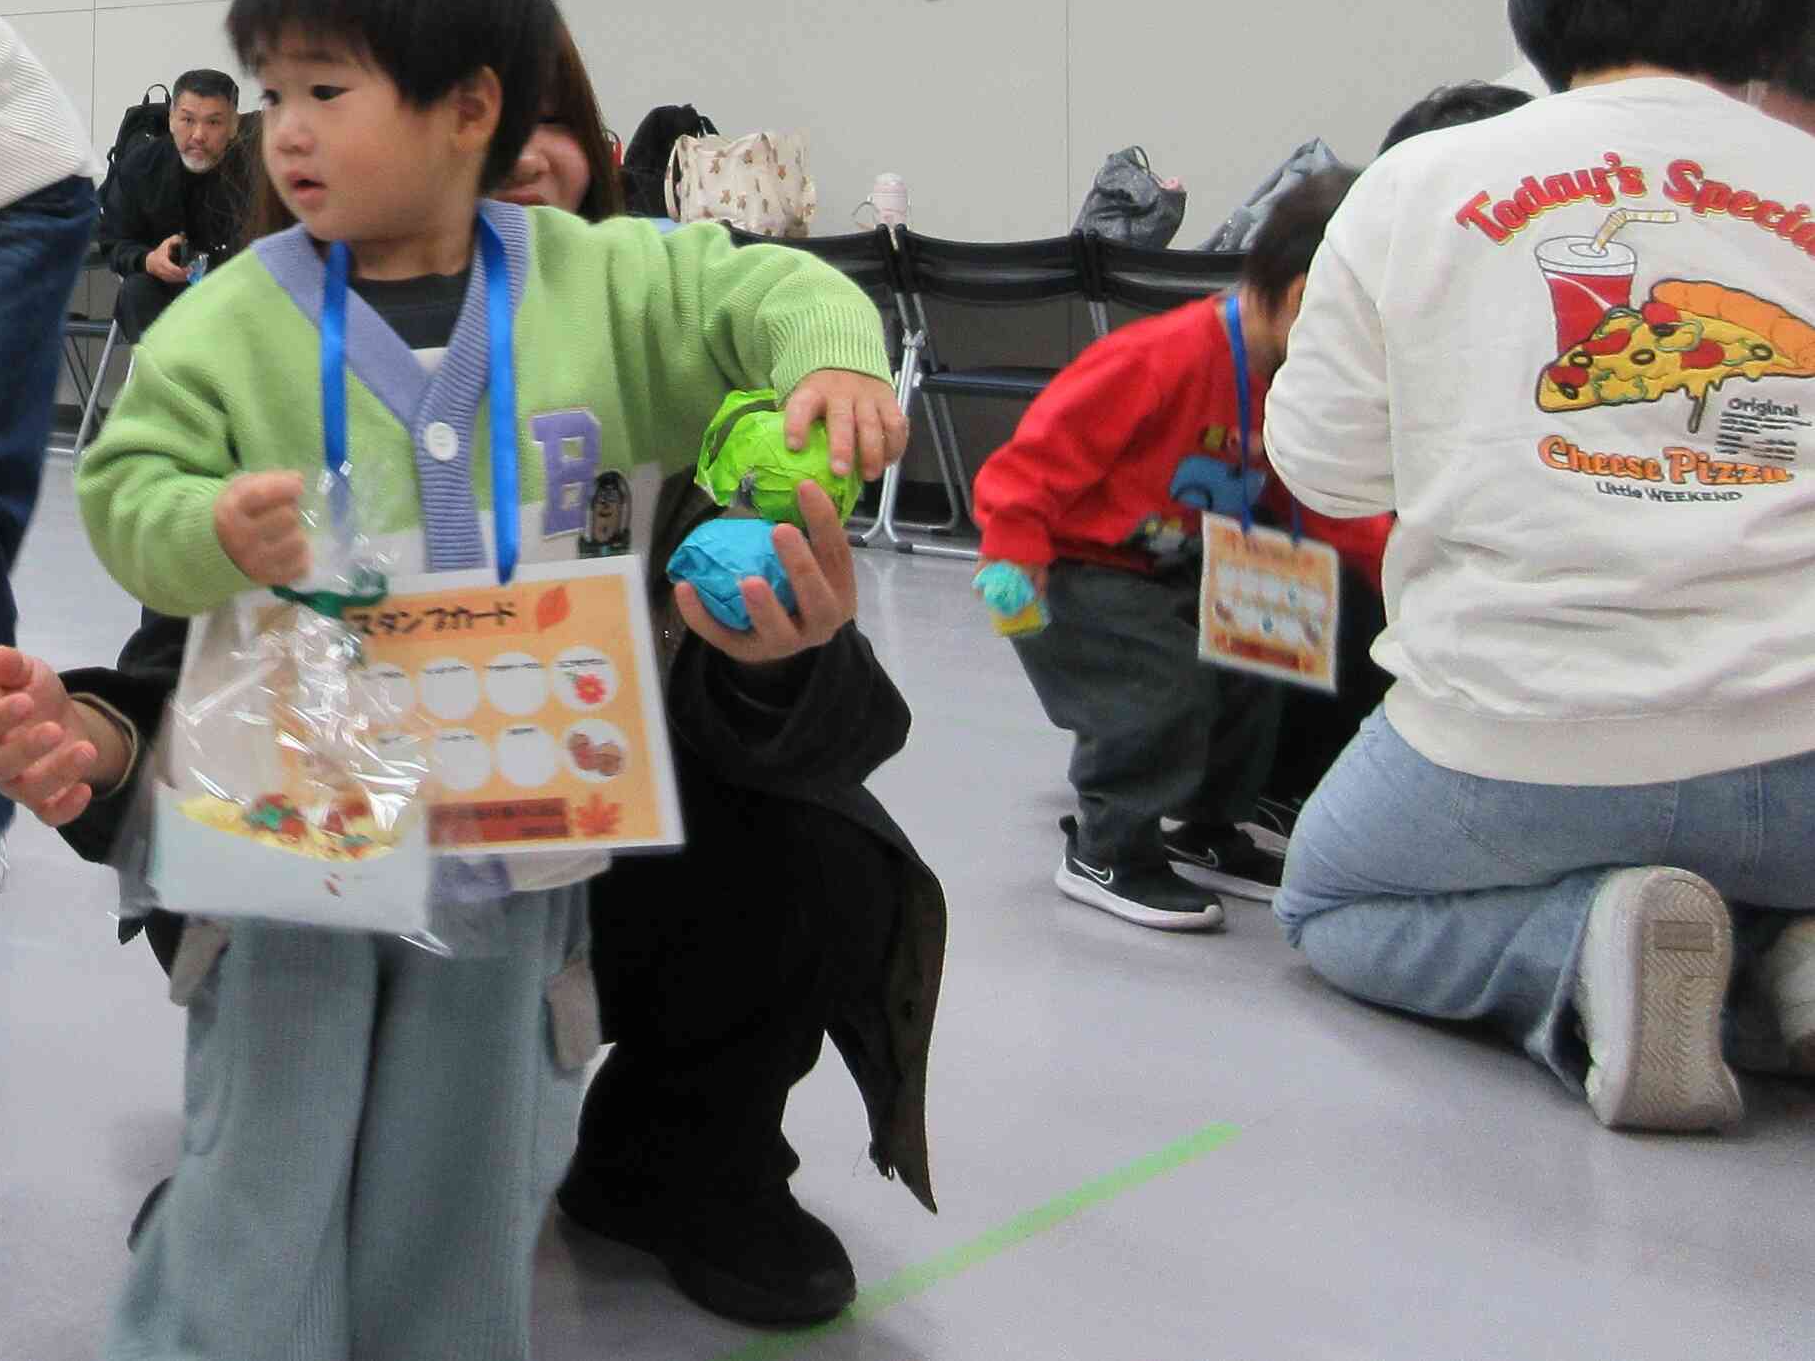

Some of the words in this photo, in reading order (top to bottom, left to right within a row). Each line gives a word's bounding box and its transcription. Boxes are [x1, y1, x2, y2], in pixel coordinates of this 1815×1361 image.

[1456, 151, 1648, 245] Today's
[1728, 397, 1800, 419] Original
[530, 408, 602, 539] B
[1537, 434, 1664, 483] Cheese
[1596, 481, 1643, 499] Little
[1645, 485, 1744, 503] WEEKEND
